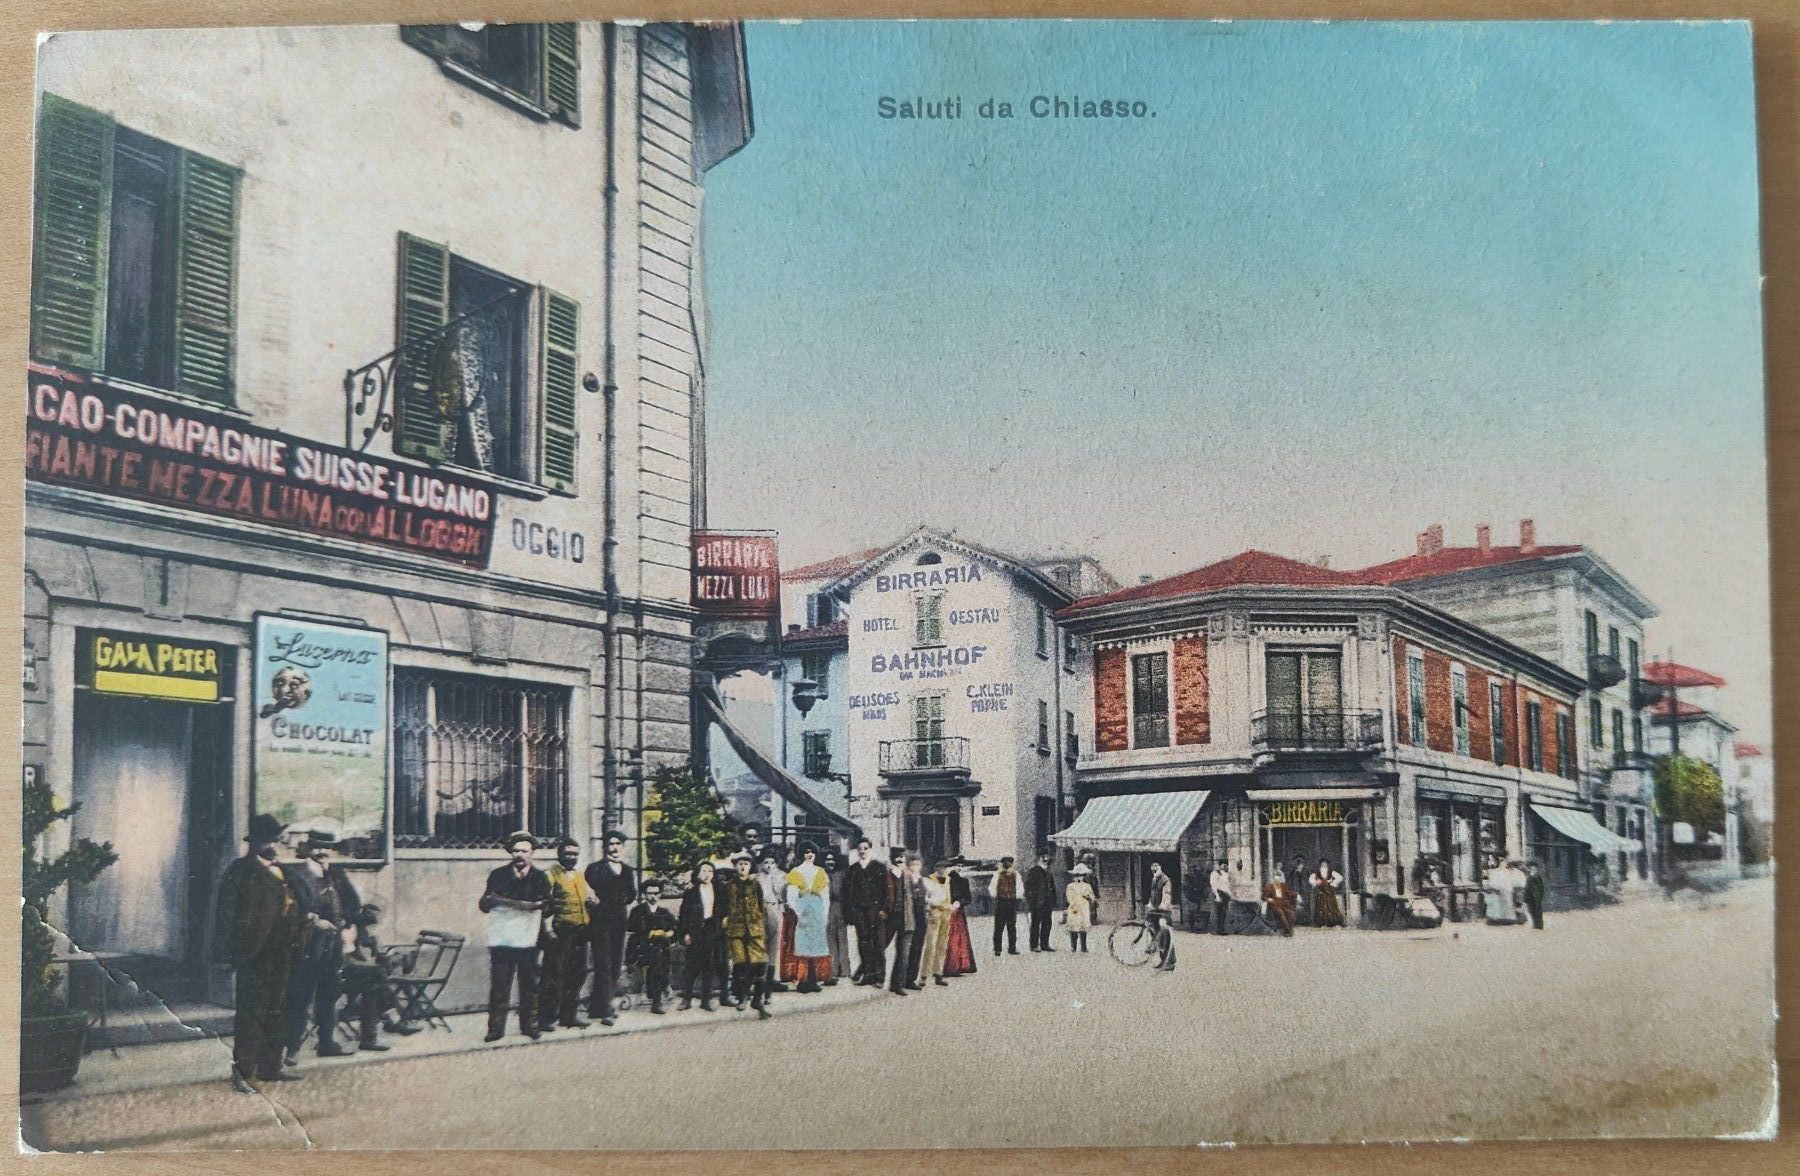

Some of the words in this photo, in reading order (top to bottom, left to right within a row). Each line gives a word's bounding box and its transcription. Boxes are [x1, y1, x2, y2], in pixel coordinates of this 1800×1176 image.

[878, 96, 962, 119] Saluti
[978, 97, 1014, 119] da
[1029, 95, 1158, 119] Chiasso.
[148, 459, 254, 513] MEZZA
[262, 481, 333, 529] LUNA
[876, 564, 982, 593] BIRRARIA
[863, 617, 900, 633] HOTEL
[96, 636, 156, 673] GALA
[157, 643, 218, 674] PETER
[871, 644, 988, 673] BAHNHOF
[270, 713, 375, 745] CHOCOLAT
[1270, 800, 1343, 823] BIRRARIA
